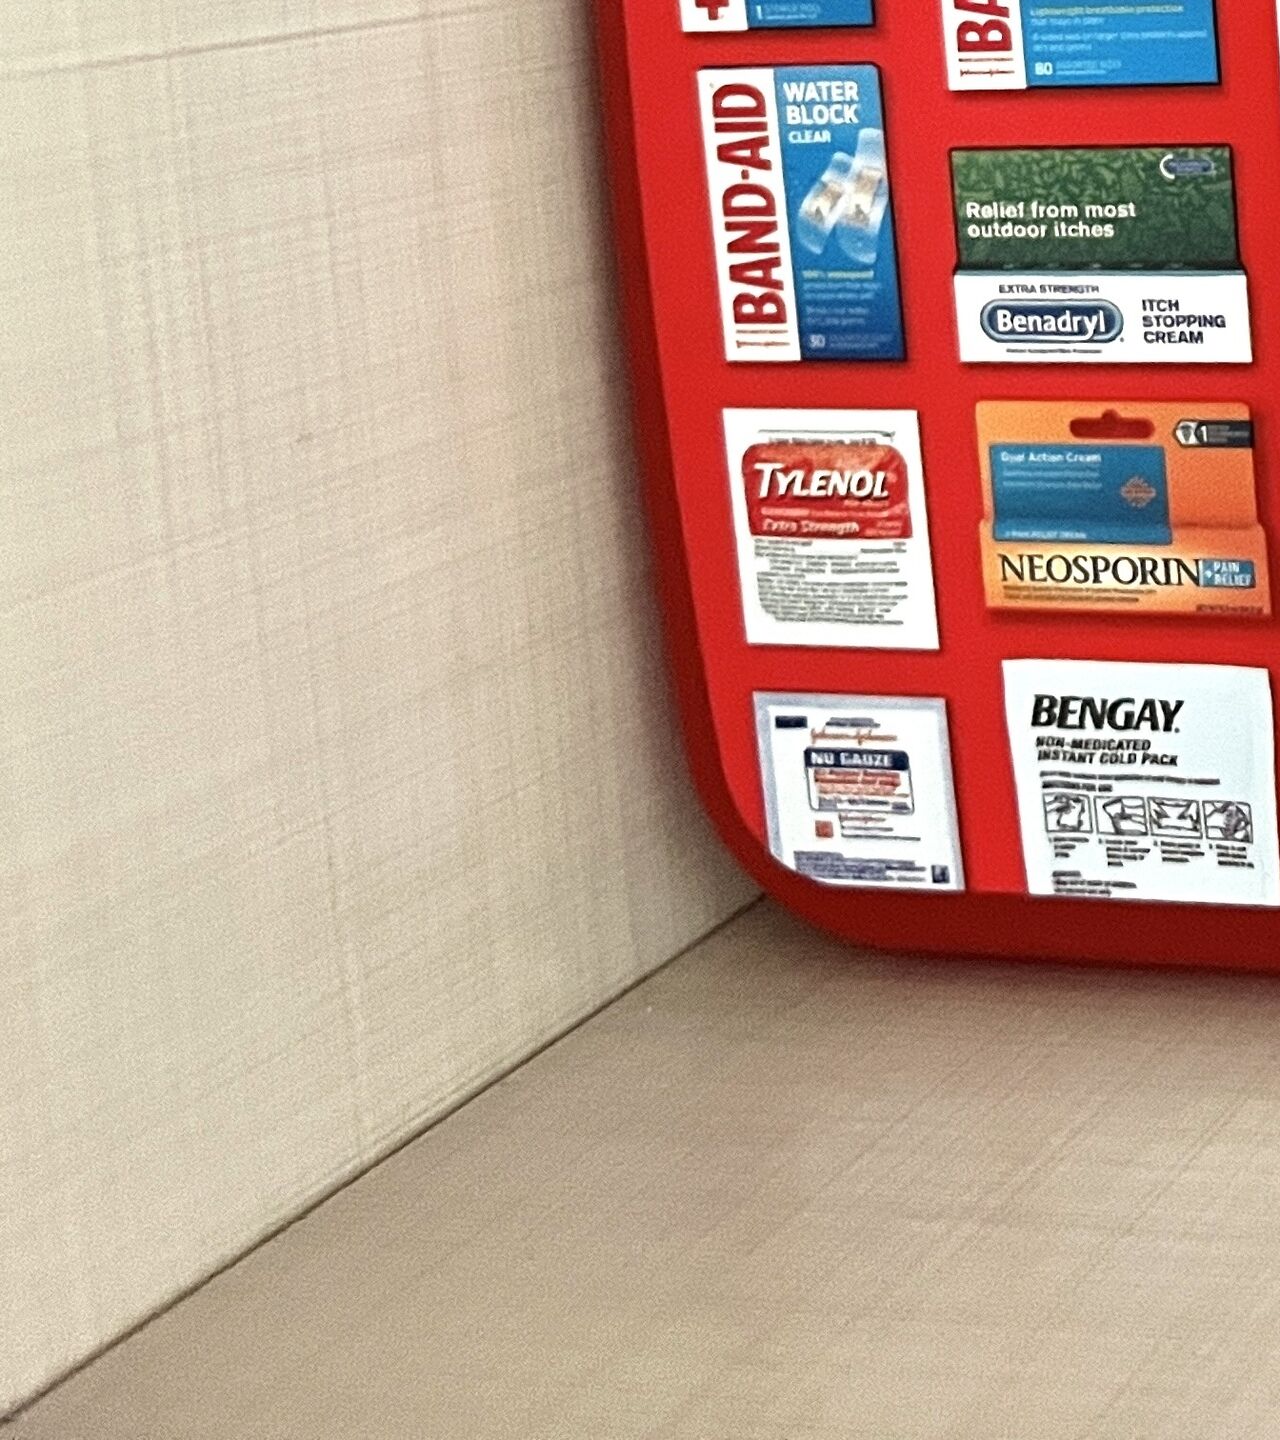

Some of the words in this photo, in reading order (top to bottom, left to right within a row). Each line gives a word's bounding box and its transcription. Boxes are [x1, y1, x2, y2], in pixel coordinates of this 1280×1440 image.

[783, 80, 859, 102] WATER
[786, 103, 859, 125] BLOCK
[788, 129, 831, 144] CLEAR
[711, 82, 789, 325] BAND-AID
[965, 201, 1025, 219] Relief
[1031, 201, 1079, 219] from
[1085, 202, 1137, 218] most
[967, 221, 1048, 239] outdoor
[1054, 220, 1115, 239] itches
[998, 284, 1037, 295] EXTRA
[1039, 284, 1100, 295] STRENGTH
[1142, 298, 1180, 313] ITCH
[995, 308, 1107, 338] Benadryl
[1142, 314, 1227, 329] STOPPING
[1143, 330, 1205, 345] CREAM
[1028, 451, 1064, 463] Action
[1066, 451, 1102, 463] Cream
[753, 462, 890, 500] TYLENOL
[997, 553, 1201, 587] NEOSPORIN
[1213, 560, 1240, 574] PAIN
[1214, 573, 1252, 587] RELIEF
[1030, 693, 1185, 733] BENGAY
[1035, 735, 1151, 752] NON-MEDICATED
[810, 751, 835, 765] NU
[1036, 749, 1095, 765] INSTANT
[1099, 750, 1137, 765] COLD
[1140, 752, 1179, 767] PACK
